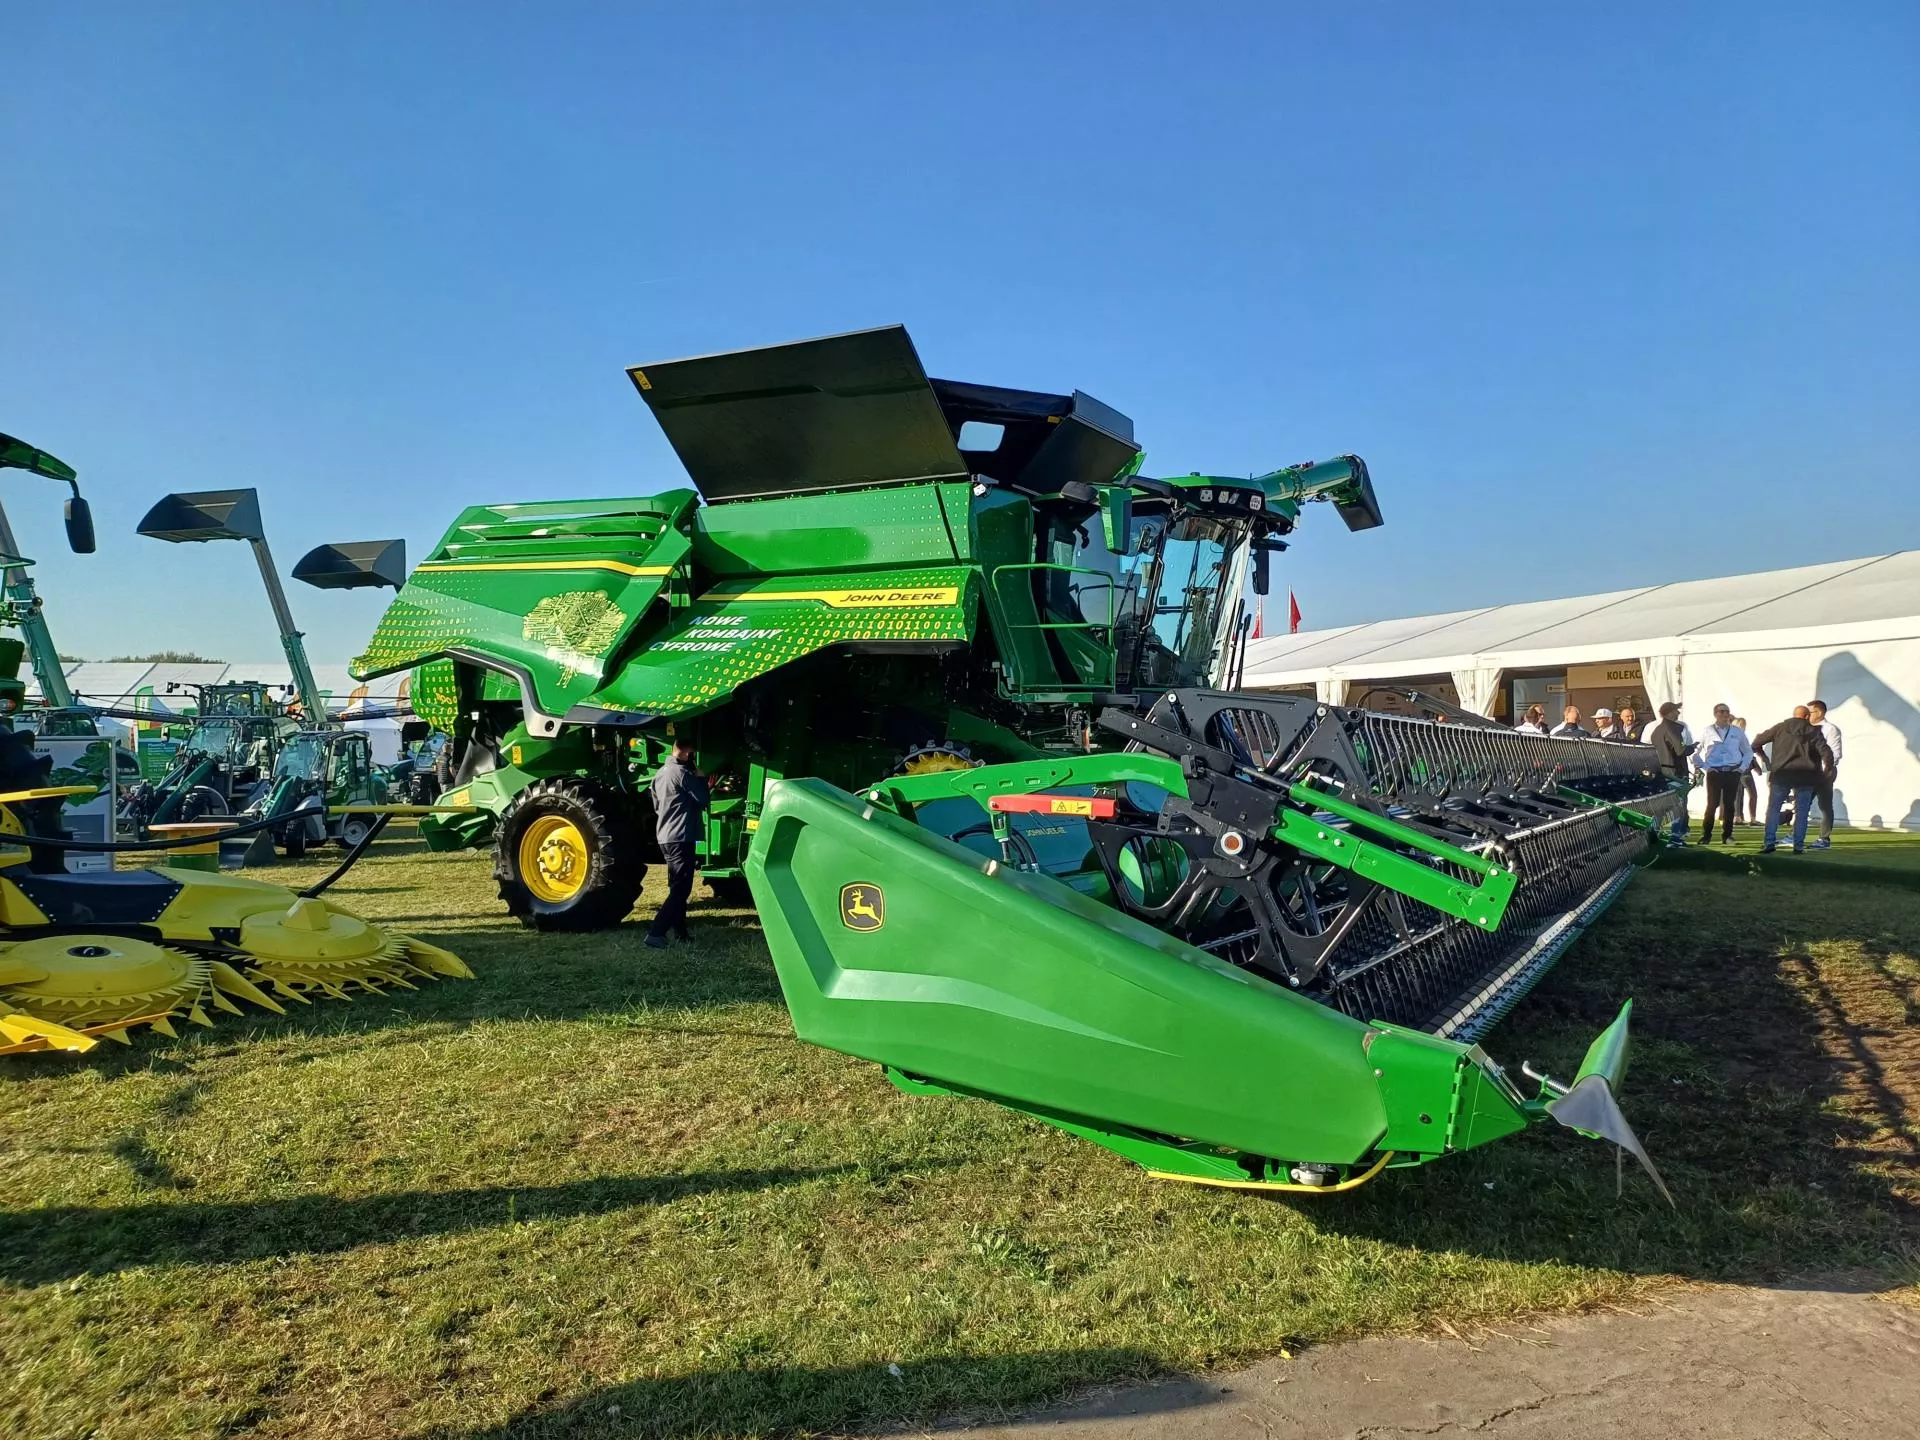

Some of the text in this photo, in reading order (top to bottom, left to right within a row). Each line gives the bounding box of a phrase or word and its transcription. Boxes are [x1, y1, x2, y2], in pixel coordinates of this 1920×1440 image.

[888, 593, 946, 602] DEERE
[689, 616, 748, 626] NOWE
[684, 629, 784, 641] KOMBAJNY
[648, 641, 737, 652] CYFROWE
[1607, 669, 1643, 681] KOLEKC
